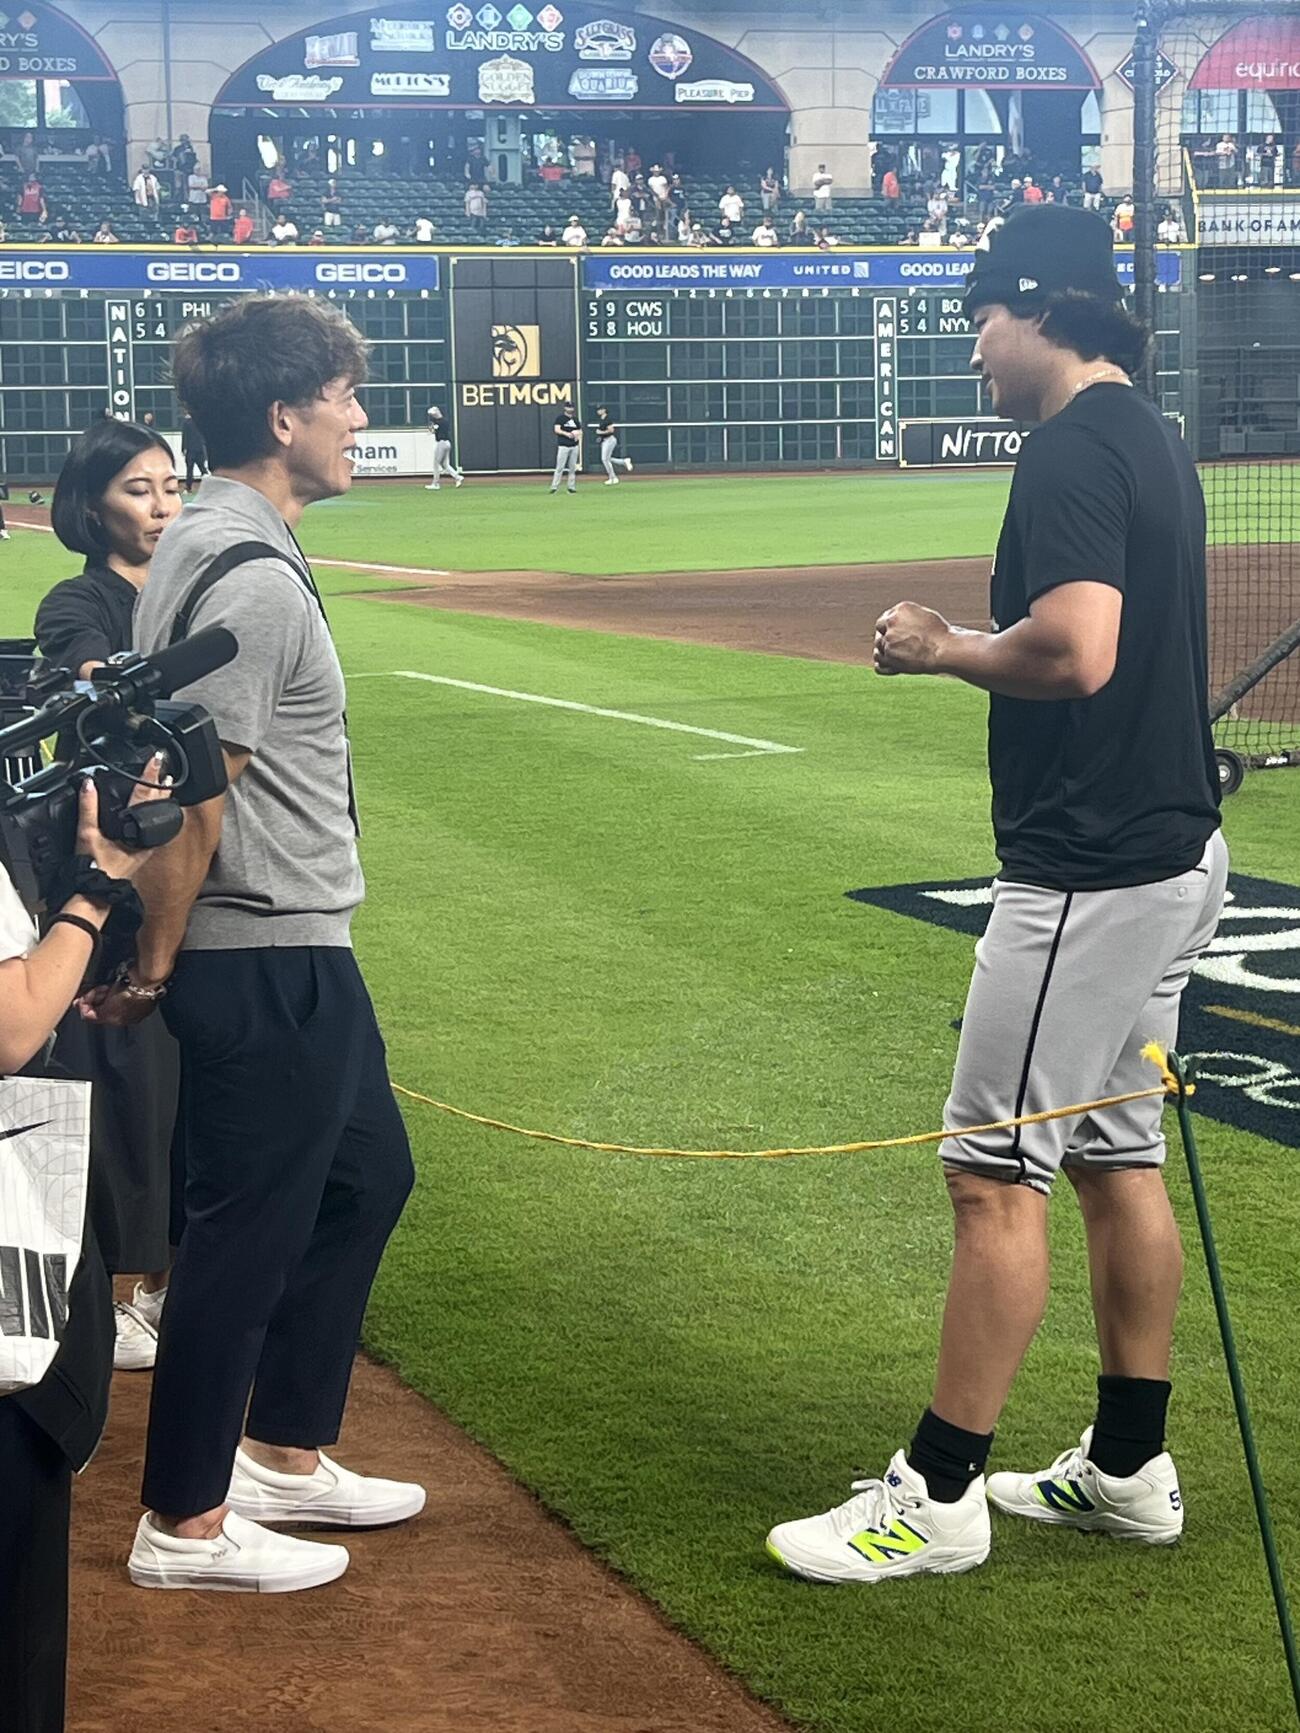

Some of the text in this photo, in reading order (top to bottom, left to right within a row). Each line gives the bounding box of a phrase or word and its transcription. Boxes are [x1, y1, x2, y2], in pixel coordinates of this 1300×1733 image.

[447, 31, 564, 51] LANDRY'S
[945, 44, 1035, 58] LANDRY'S
[18, 57, 77, 71] BOXES
[914, 66, 1067, 81] CRAWFORD BOXES
[147, 262, 240, 281] GEICO
[315, 263, 406, 282] GEICO
[610, 264, 762, 278] GOOD LEADS THE WAY
[793, 265, 850, 275] UNITED
[900, 263, 944, 276] GOOD
[182, 302, 211, 317] PHI
[626, 302, 663, 316] CWS
[627, 321, 662, 336] HOU
[939, 318, 970, 332] NYY
[877, 303, 894, 455] AMERICAN
[462, 383, 571, 406] BETMGM
[941, 425, 1022, 458] NITTO
[1169, 1490, 1181, 1511] 5
